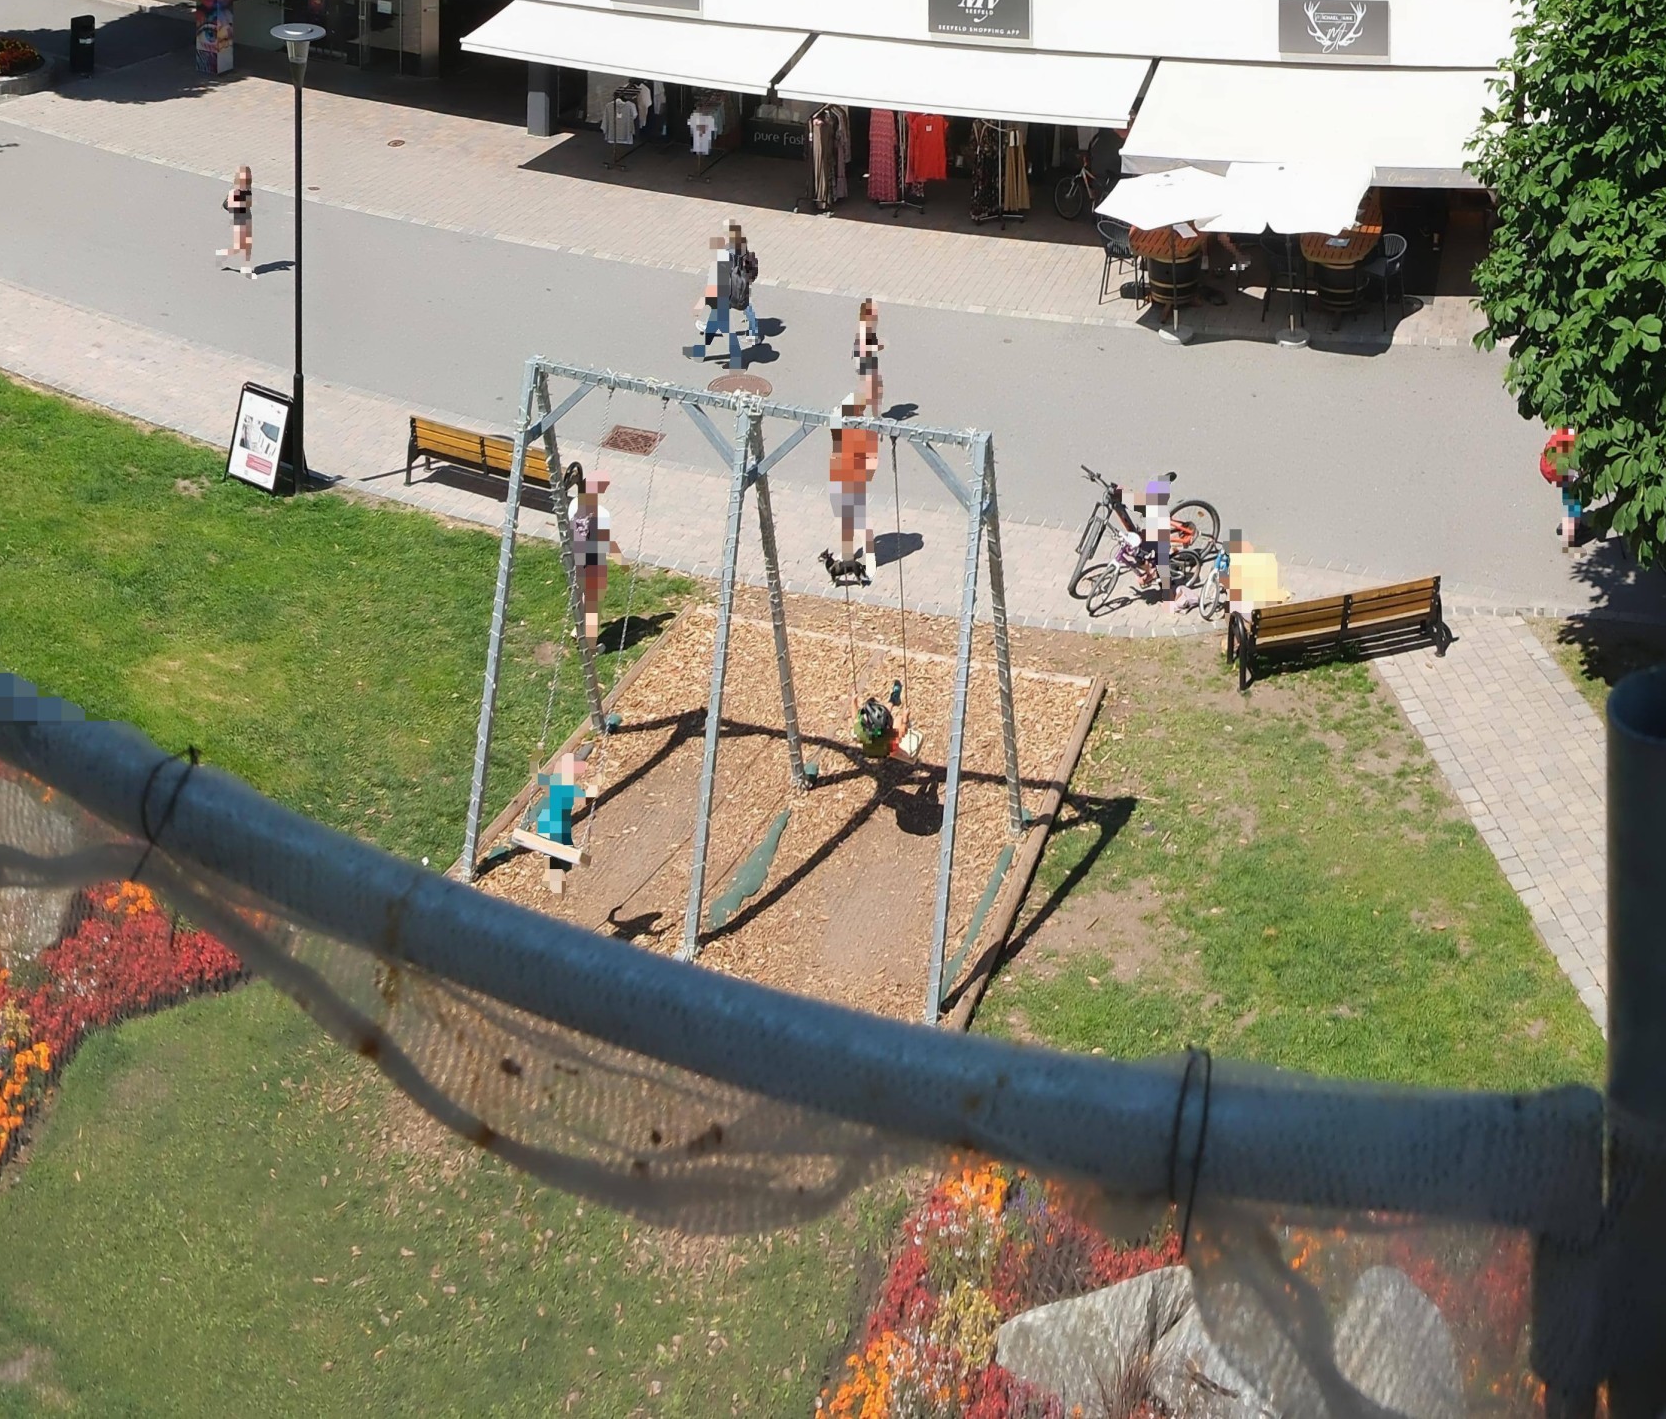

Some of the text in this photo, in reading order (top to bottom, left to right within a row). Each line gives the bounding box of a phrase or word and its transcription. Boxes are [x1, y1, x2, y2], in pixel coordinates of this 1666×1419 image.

[965, 8, 994, 16] SEEFELD
[938, 24, 967, 32] SEEFELD
[969, 27, 1005, 35] SHOPPING
[754, 131, 780, 142] pure
